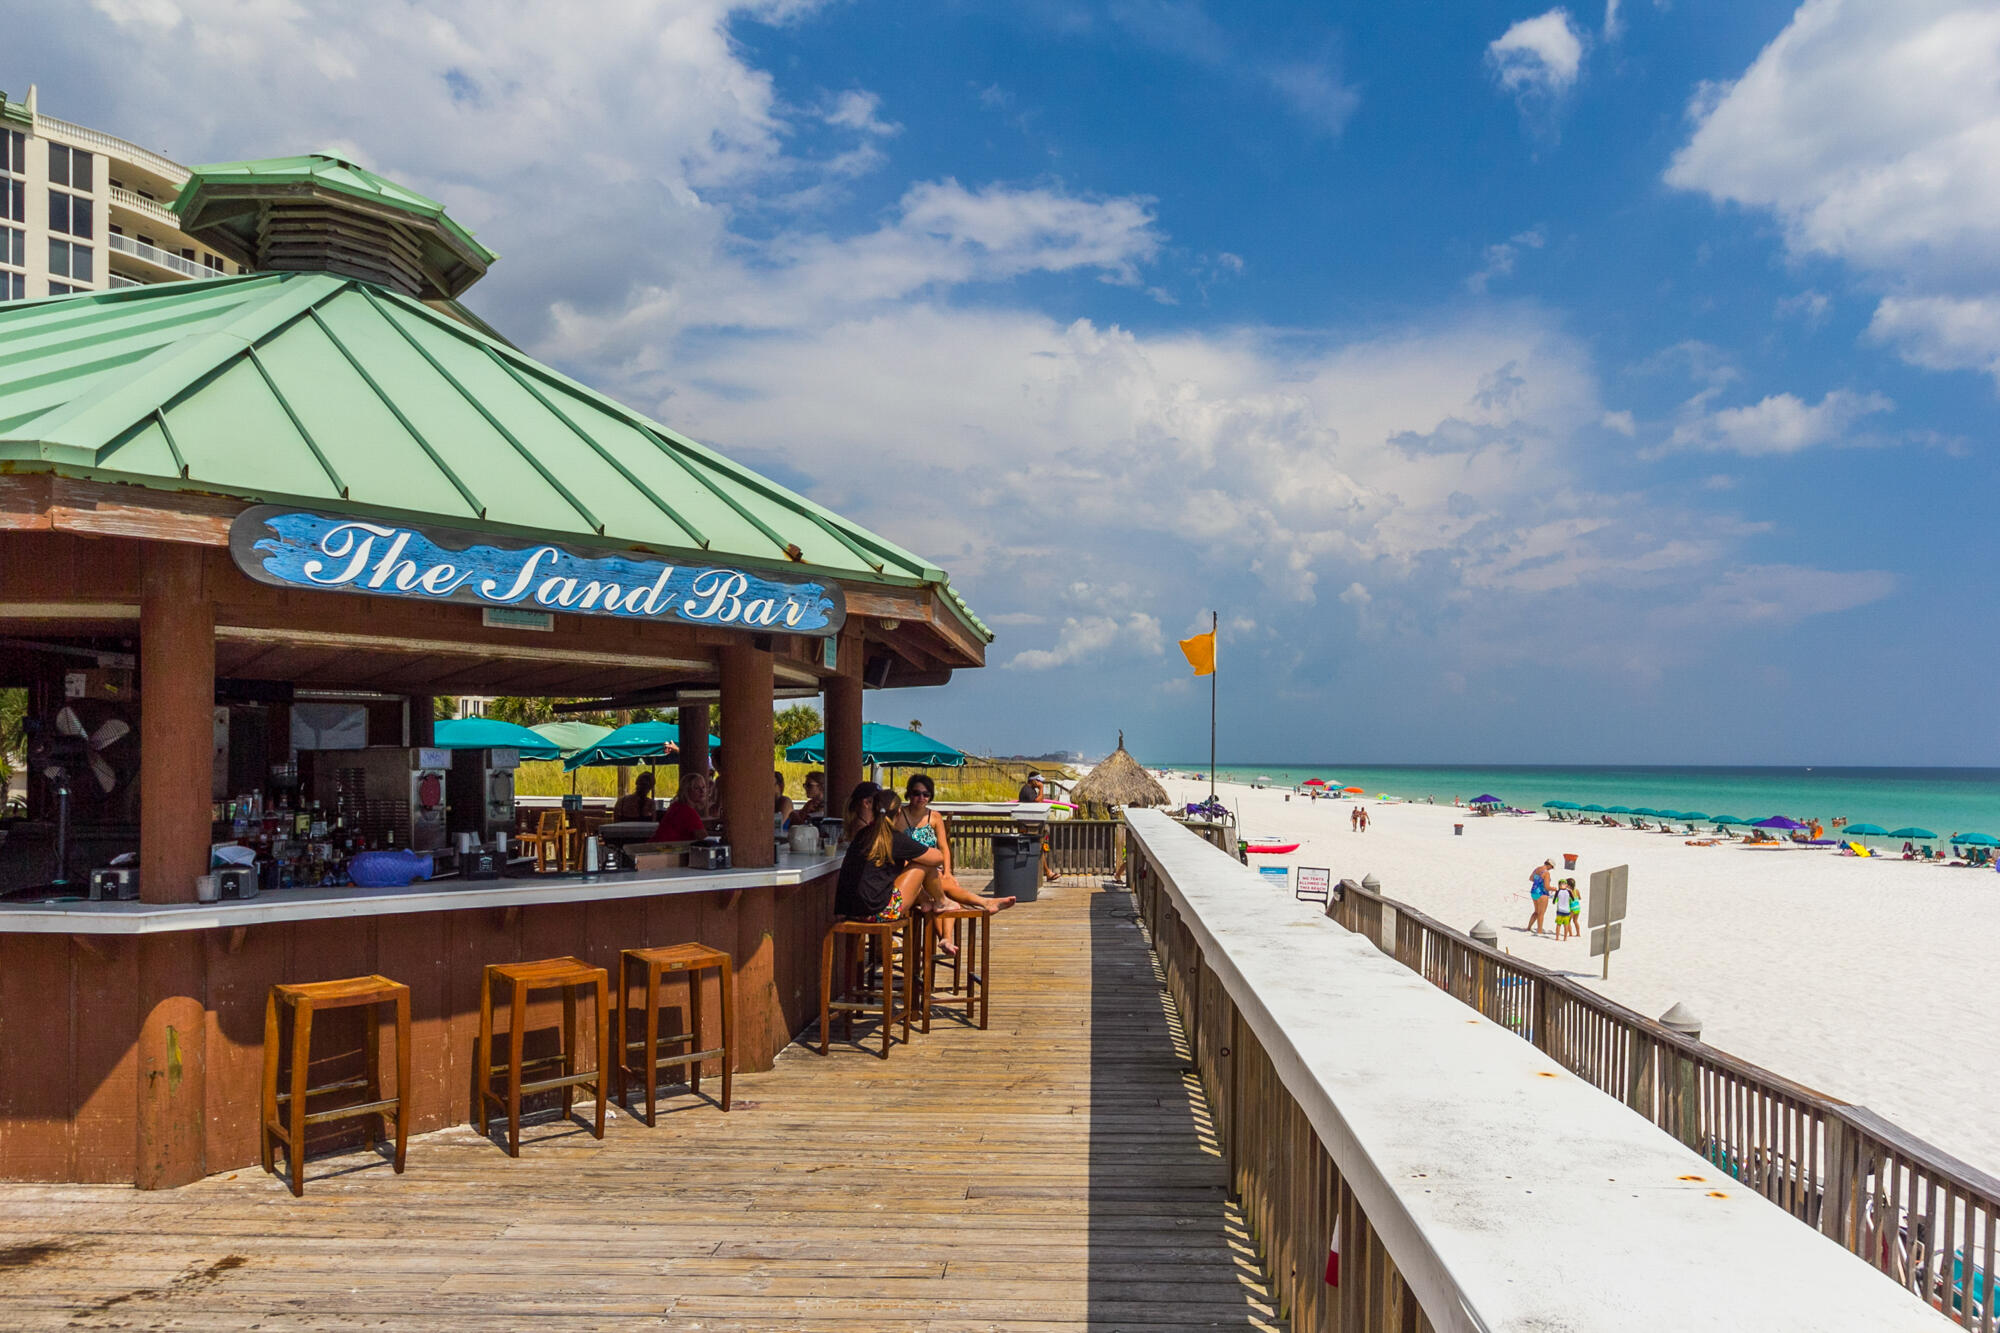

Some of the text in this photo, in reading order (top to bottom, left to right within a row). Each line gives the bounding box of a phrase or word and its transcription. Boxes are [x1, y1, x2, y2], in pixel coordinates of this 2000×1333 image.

[303, 522, 810, 627] The Sand Bar
